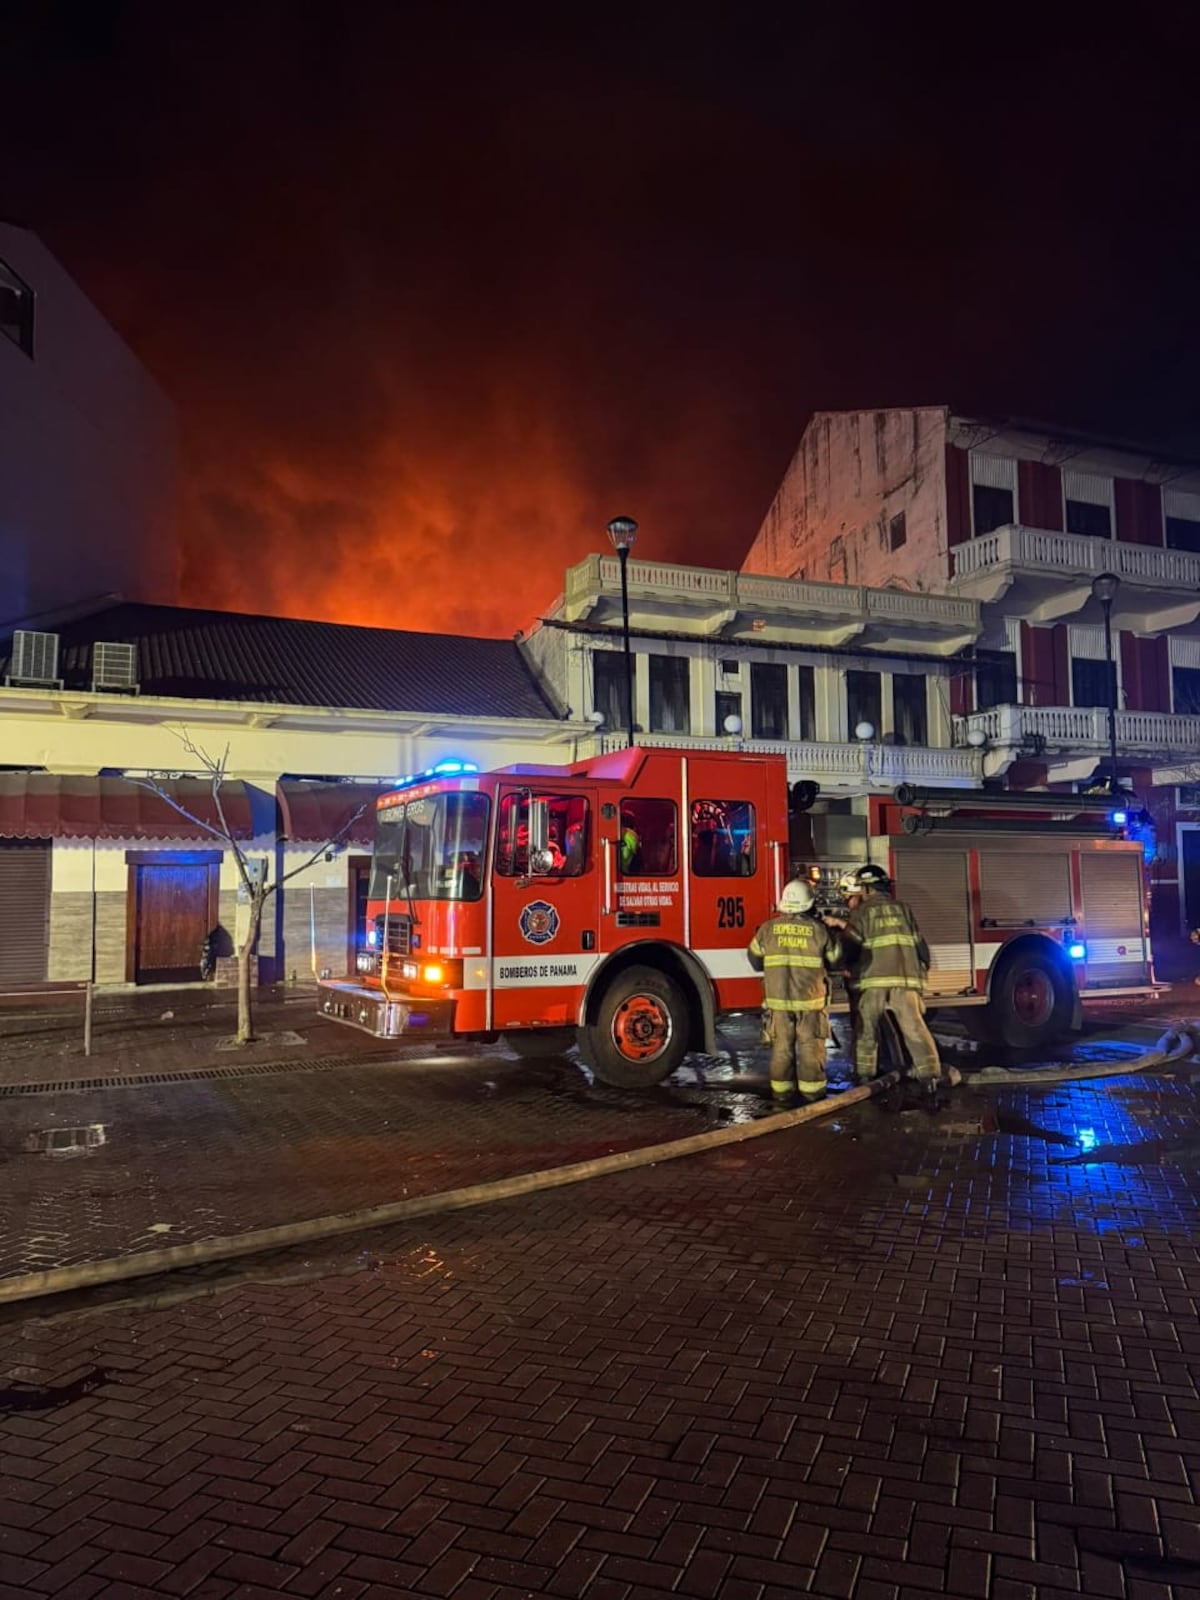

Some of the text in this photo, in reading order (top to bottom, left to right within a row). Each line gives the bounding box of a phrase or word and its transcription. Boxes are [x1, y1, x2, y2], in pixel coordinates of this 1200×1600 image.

[717, 896, 745, 929] 295
[773, 923, 813, 937] BOMBEROS
[778, 936, 808, 948] PANAMA
[500, 964, 577, 978] BOMBEROS DE PANAMA
